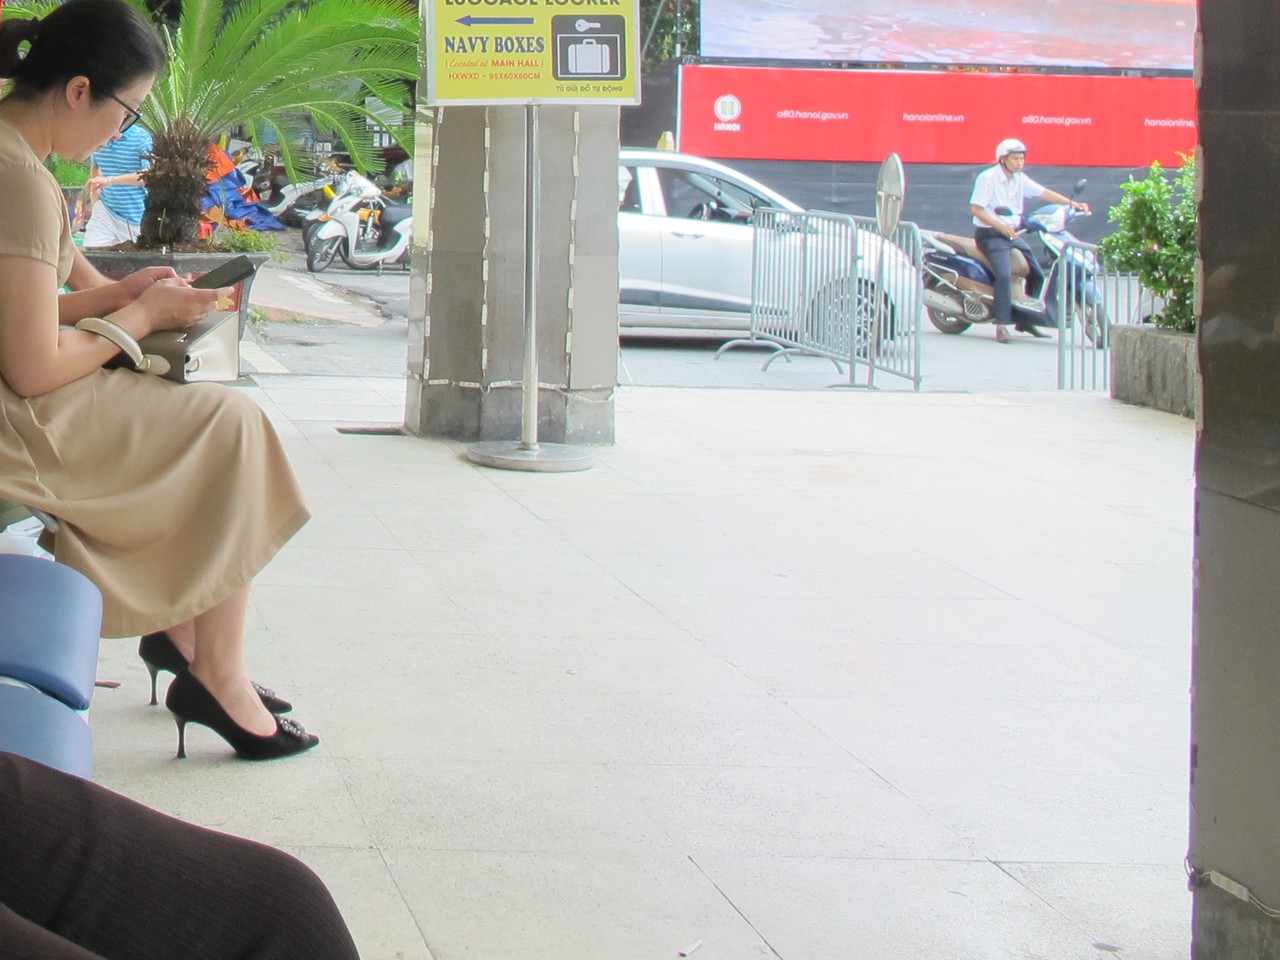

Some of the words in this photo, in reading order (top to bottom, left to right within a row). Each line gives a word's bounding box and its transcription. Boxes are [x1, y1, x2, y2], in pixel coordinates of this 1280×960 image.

[445, 36, 489, 53] NAVY
[494, 36, 544, 53] BOXES
[776, 109, 849, 121] a80.hanoi.gov.vn
[903, 112, 965, 123] hanoionline.vn
[1022, 115, 1092, 126] a80.hanoi.gov.vn
[1144, 117, 1195, 128] hanoionline.
